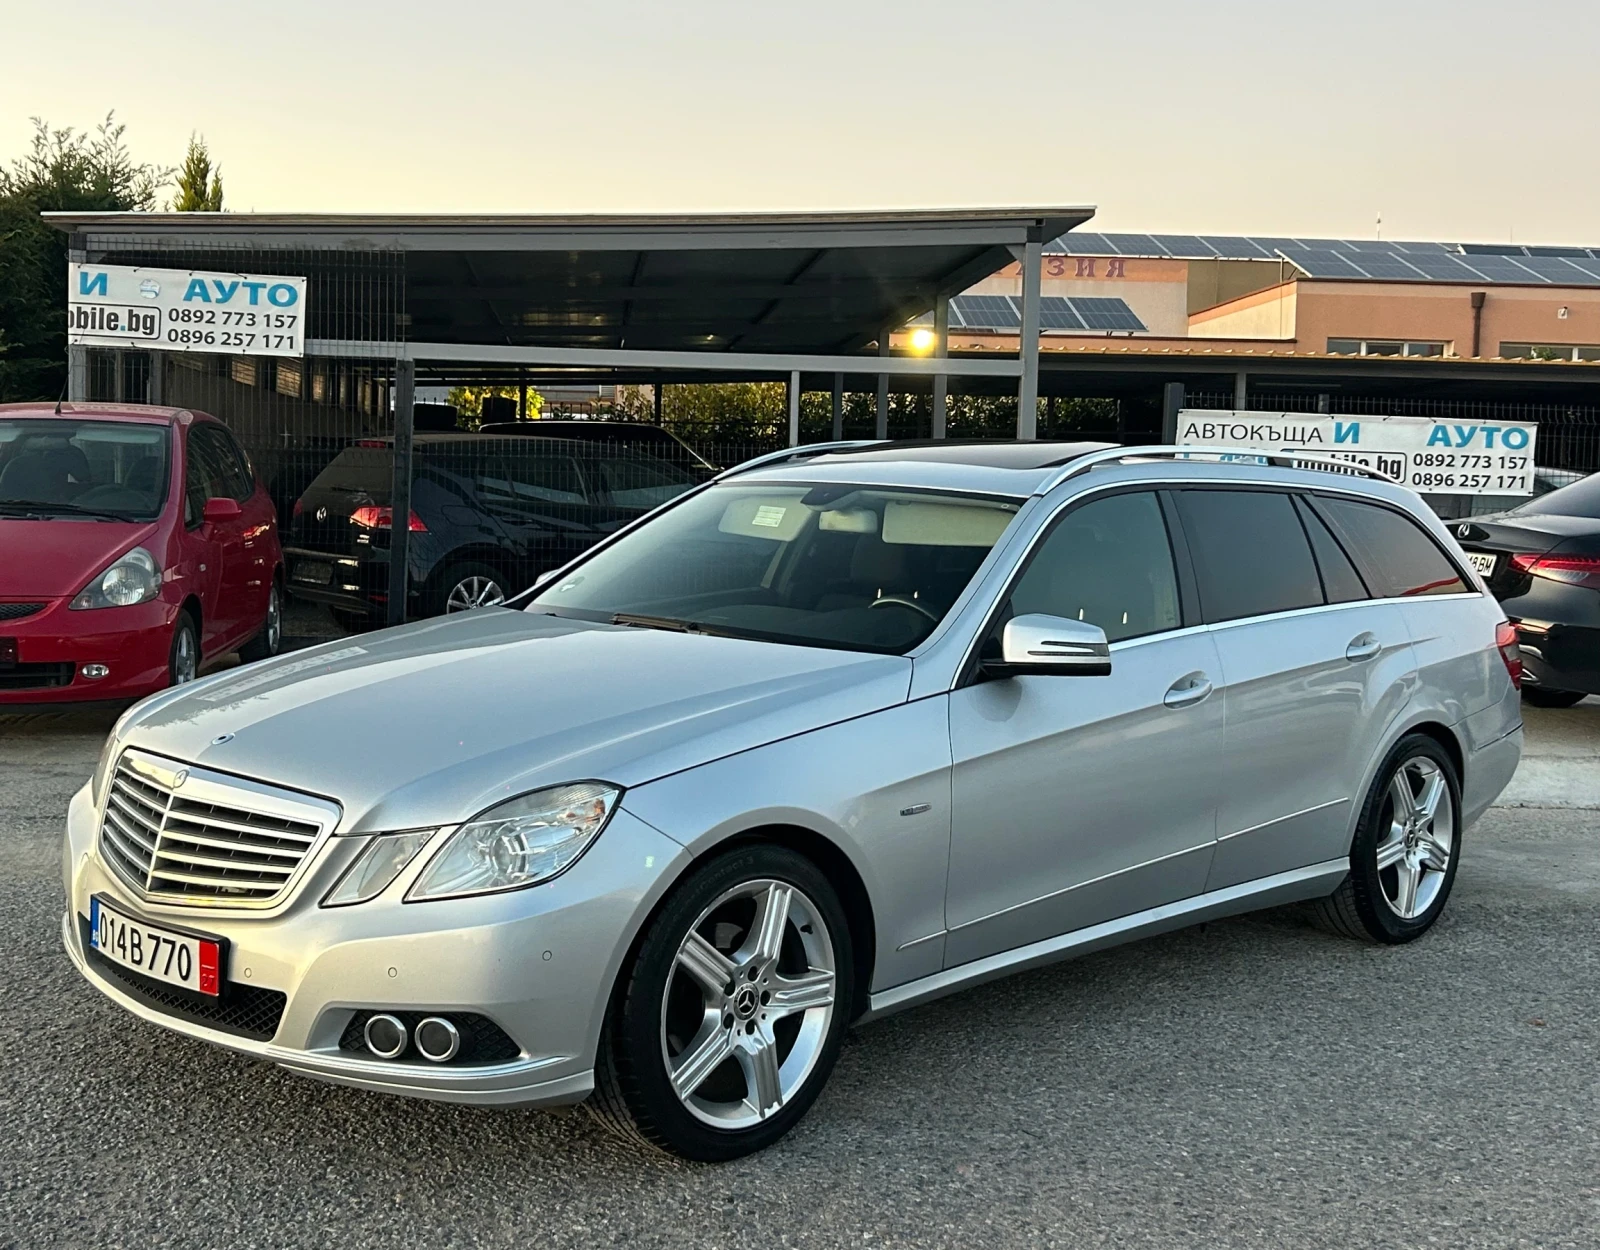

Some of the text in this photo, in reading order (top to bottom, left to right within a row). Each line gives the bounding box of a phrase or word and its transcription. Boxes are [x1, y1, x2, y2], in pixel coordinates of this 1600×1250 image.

[996, 256, 1126, 277] ЗИЯ
[79, 272, 298, 308] И АУТО
[168, 308, 298, 329] 0892 773 157
[167, 328, 295, 349] 0896 257 171
[1183, 422, 1530, 450] АВТОКЪЩА И АУТО
[1413, 453, 1527, 470] 0892 773 157
[1412, 472, 1526, 489] 0896 257 171
